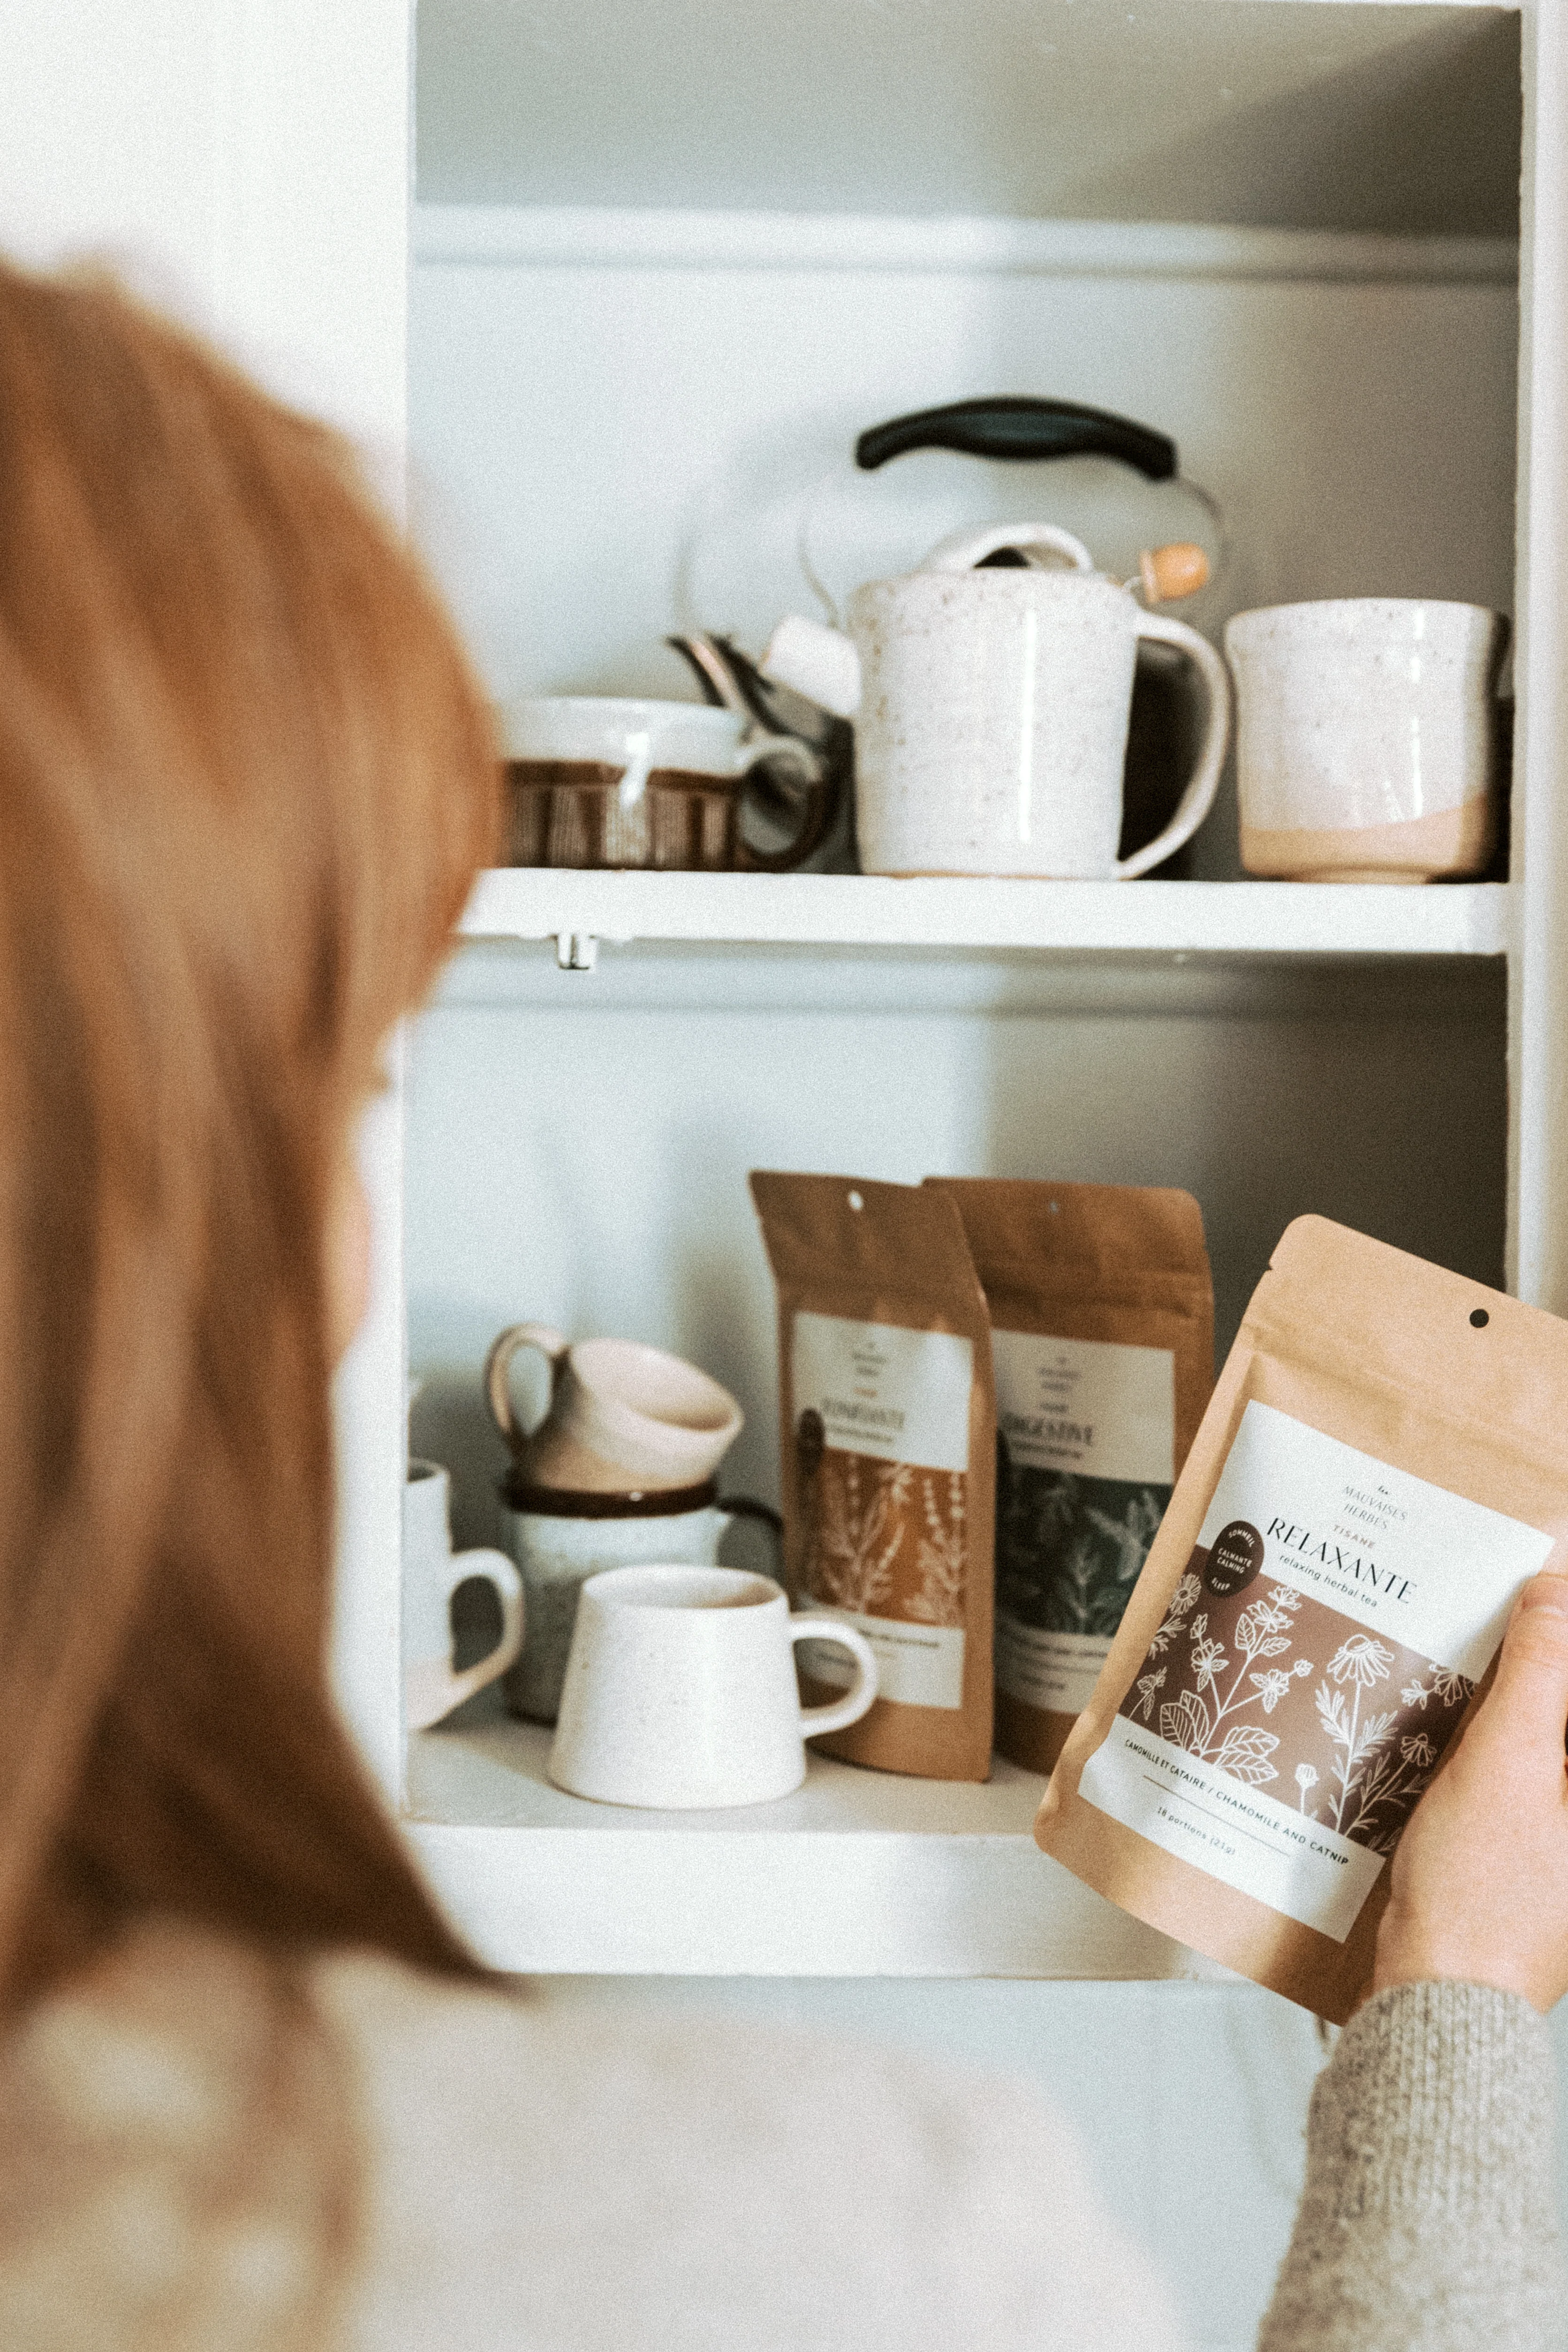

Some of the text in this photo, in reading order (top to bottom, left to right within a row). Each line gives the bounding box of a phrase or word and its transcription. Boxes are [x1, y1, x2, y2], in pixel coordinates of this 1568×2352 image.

[1342, 1485, 1408, 1521] MAUVAISES
[1343, 1503, 1388, 1530] HERBES
[1333, 1524, 1376, 1548] TISANE
[1217, 1556, 1245, 1574] CALMING
[1218, 1548, 1253, 1568] CALMANTE
[1267, 1517, 1417, 1604] RELAXANTE
[1279, 1555, 1378, 1607] relaxing herbal tea
[1125, 1739, 1159, 1764] CAMOMILLE
[1160, 1759, 1170, 1769] ET
[1170, 1765, 1207, 1790] CATAIRE
[1216, 1791, 1280, 1830] CHAMOMILE
[1282, 1828, 1306, 1844] AND
[1310, 1841, 1349, 1865] CATNIP
[1158, 1806, 1167, 1817] 18
[1168, 1814, 1207, 1839] portions
